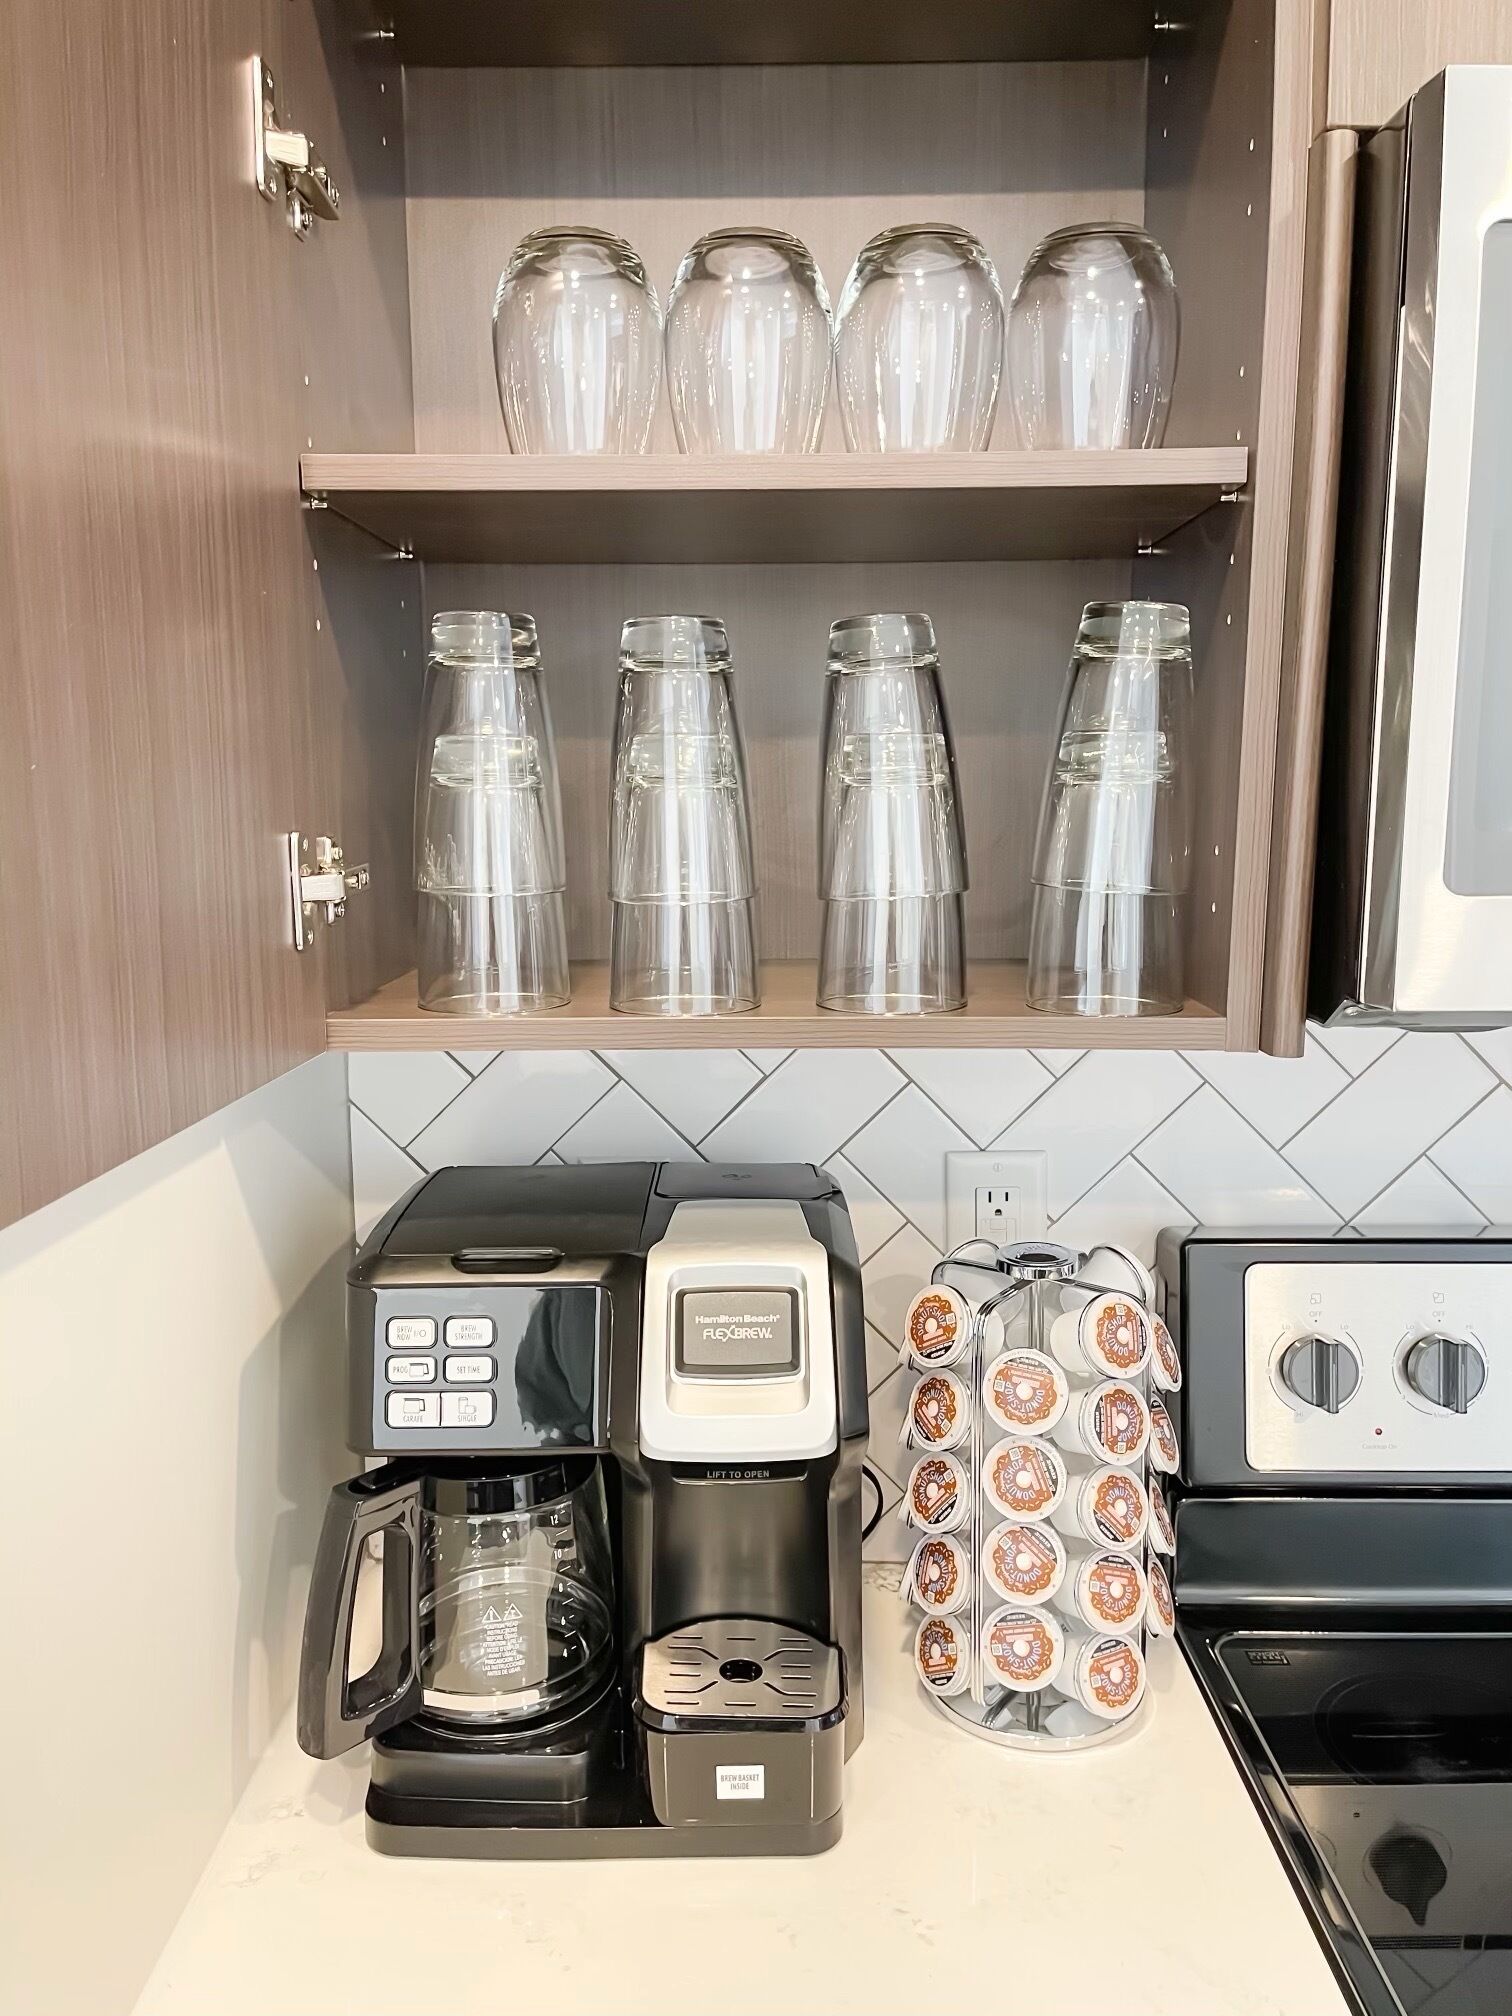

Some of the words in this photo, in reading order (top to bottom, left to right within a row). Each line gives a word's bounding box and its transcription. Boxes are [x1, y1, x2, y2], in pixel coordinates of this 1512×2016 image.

[695, 1315, 743, 1324] Hamilton
[455, 1333, 482, 1341] STRENGTH
[393, 1366, 409, 1374] PROG
[457, 1366, 466, 1374] SET
[467, 1366, 481, 1374] TIME
[403, 1415, 424, 1423] CARAFE
[457, 1415, 477, 1423] SINGLE
[707, 1470, 726, 1479] LIFT
[729, 1471, 741, 1479] TO
[744, 1470, 770, 1478] OPEN
[550, 1514, 559, 1525] 12
[553, 1548, 562, 1560] 10
[561, 1616, 566, 1626] 6
[562, 1648, 568, 1658] 4
[721, 1774, 737, 1782] BREW
[738, 1773, 760, 1781] BASKET
[730, 1782, 750, 1790] INSIDE
